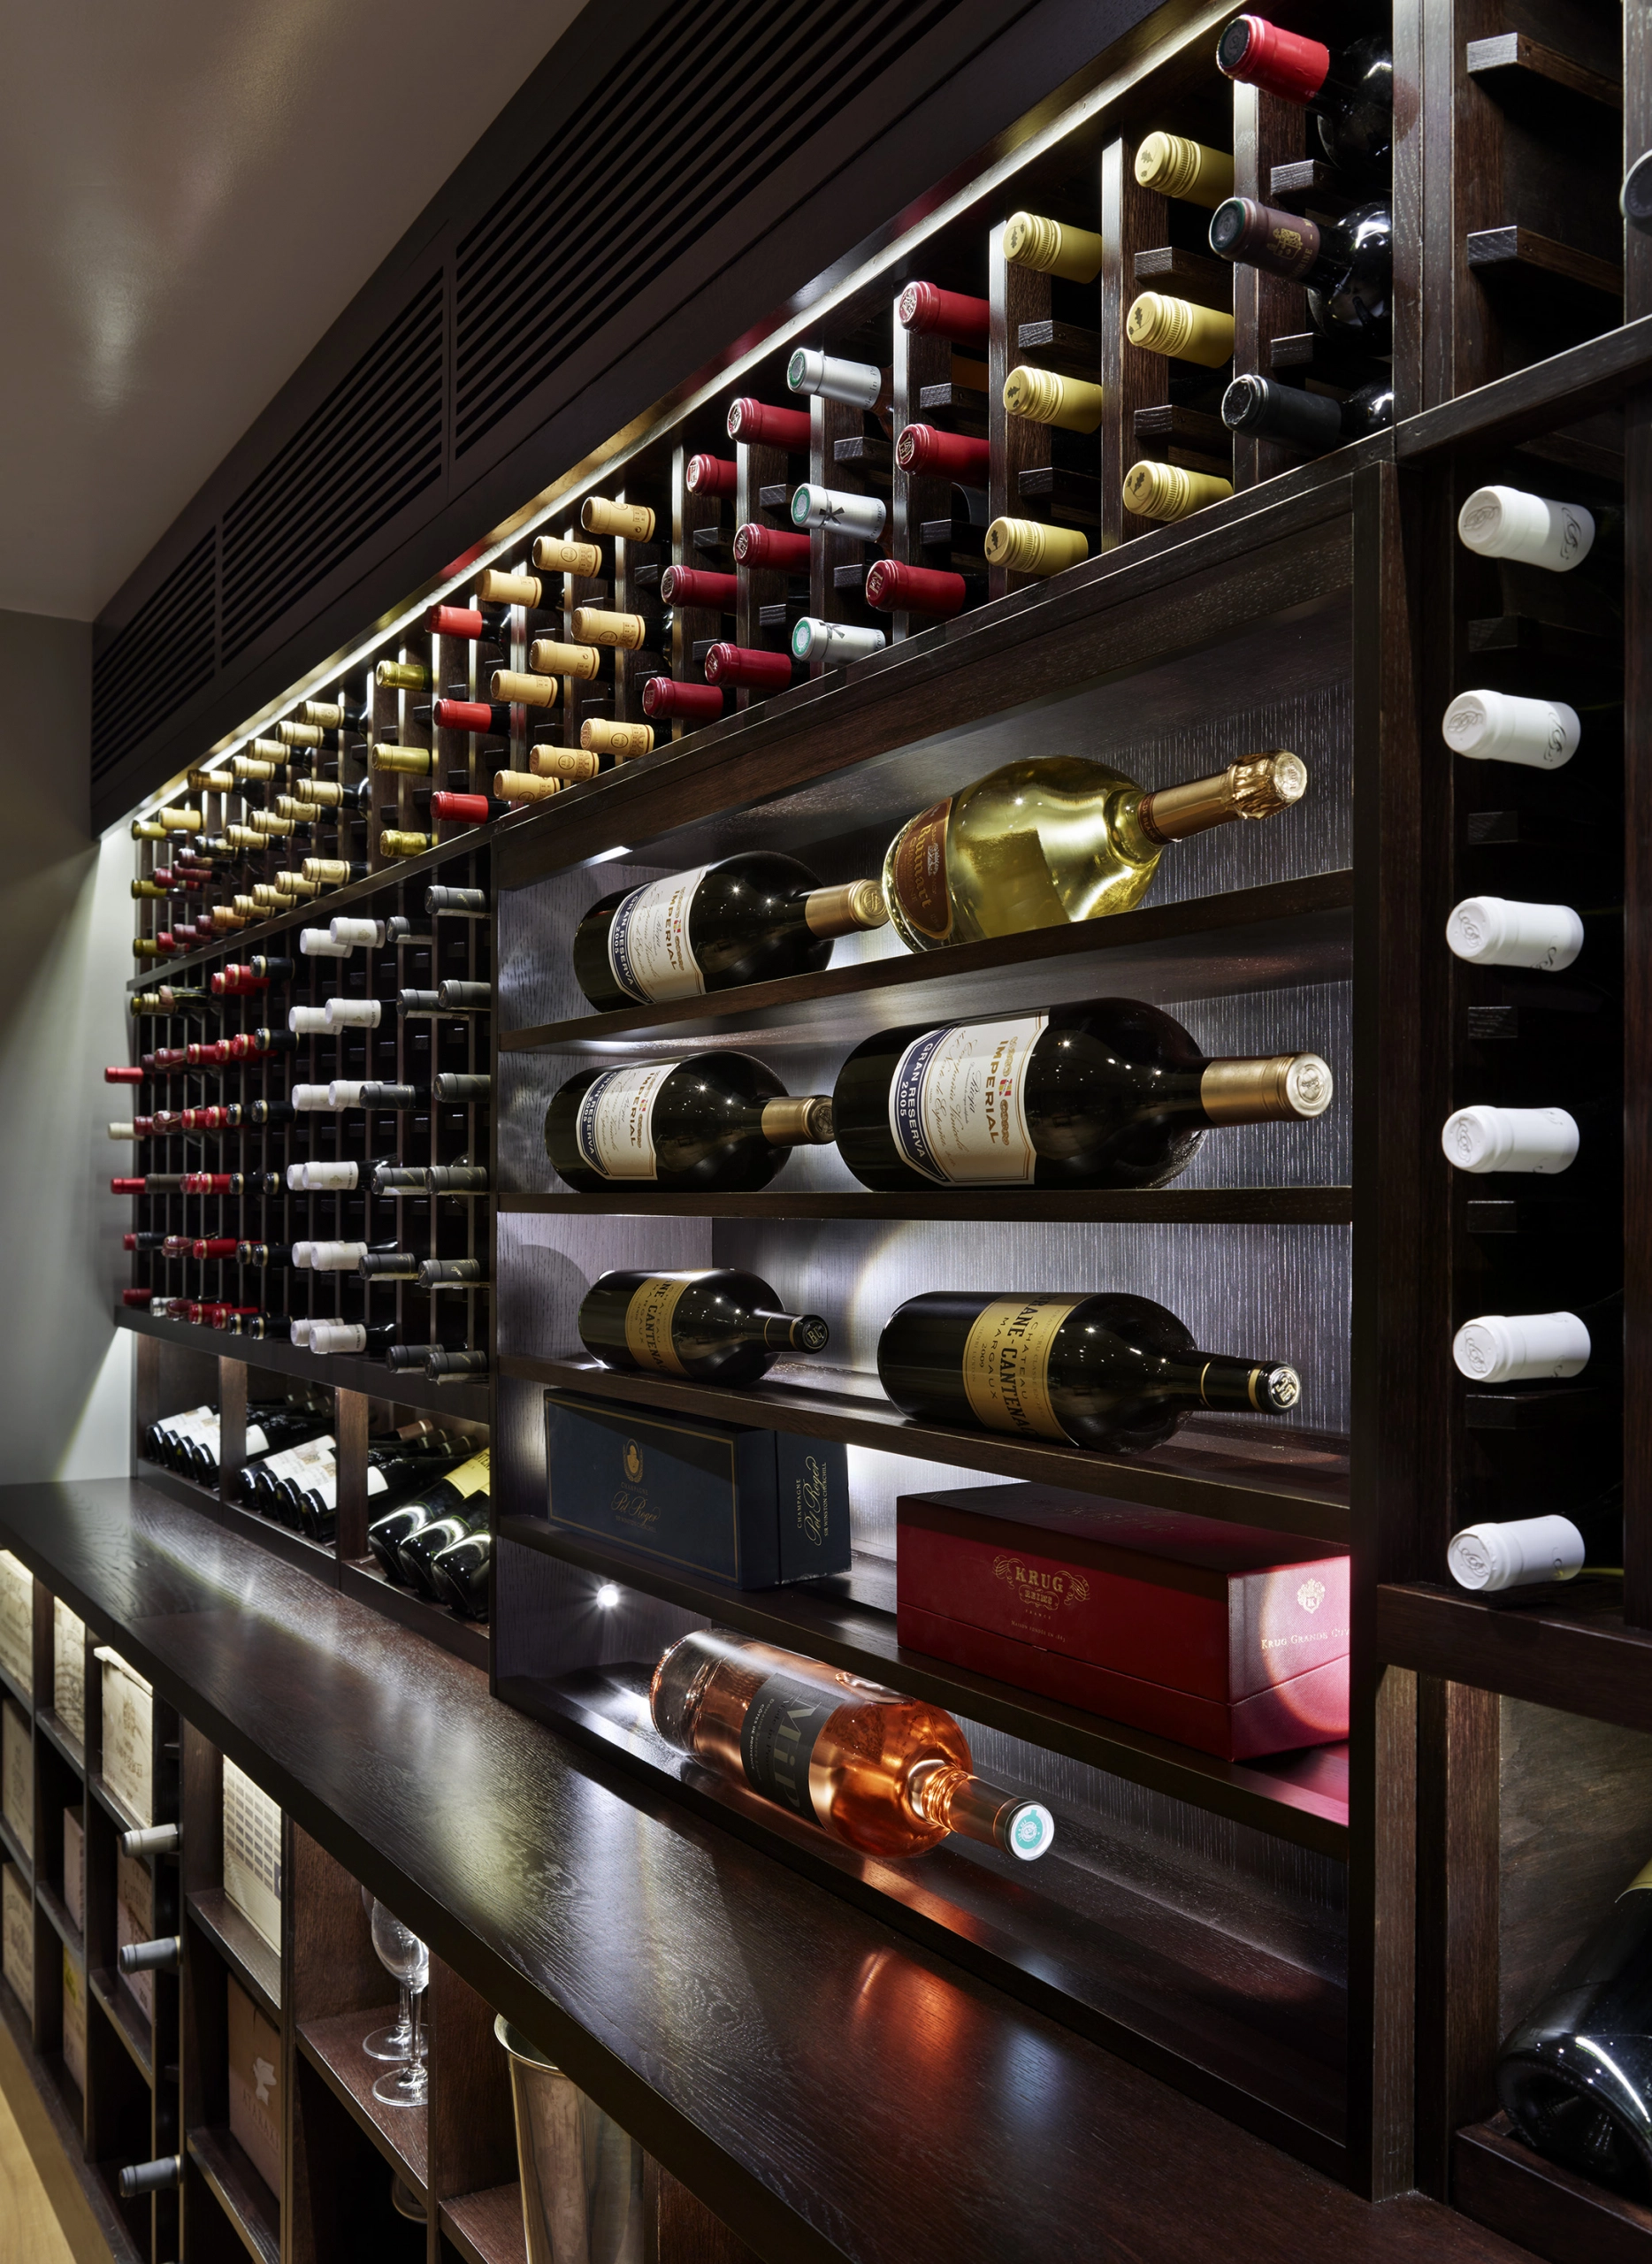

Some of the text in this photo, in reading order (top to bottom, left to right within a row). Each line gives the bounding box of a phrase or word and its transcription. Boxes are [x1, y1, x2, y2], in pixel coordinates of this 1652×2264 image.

[914, 822, 933, 909] Ruinart
[619, 895, 639, 985] GRAN RESERVA
[665, 890, 680, 970] IMPERIAL
[629, 1073, 655, 1147] IMPERIAL
[899, 1081, 909, 1117] 2005
[907, 1043, 935, 1158] GRAN RESERVA
[985, 1039, 1009, 1144] IMPERIAL
[586, 1100, 597, 1154] RESERVA
[979, 1343, 988, 1368] 2009
[988, 1317, 1010, 1400] MARGAUX
[802, 1456, 826, 1547] Pol Roger
[1015, 1566, 1064, 1594] KRUG
[1024, 1589, 1053, 1606] REIMS
[1261, 1628, 1350, 1650] KRUG GRANDE CUV
[750, 1725, 755, 1734] DE
[753, 1703, 765, 1725] CÔTES
